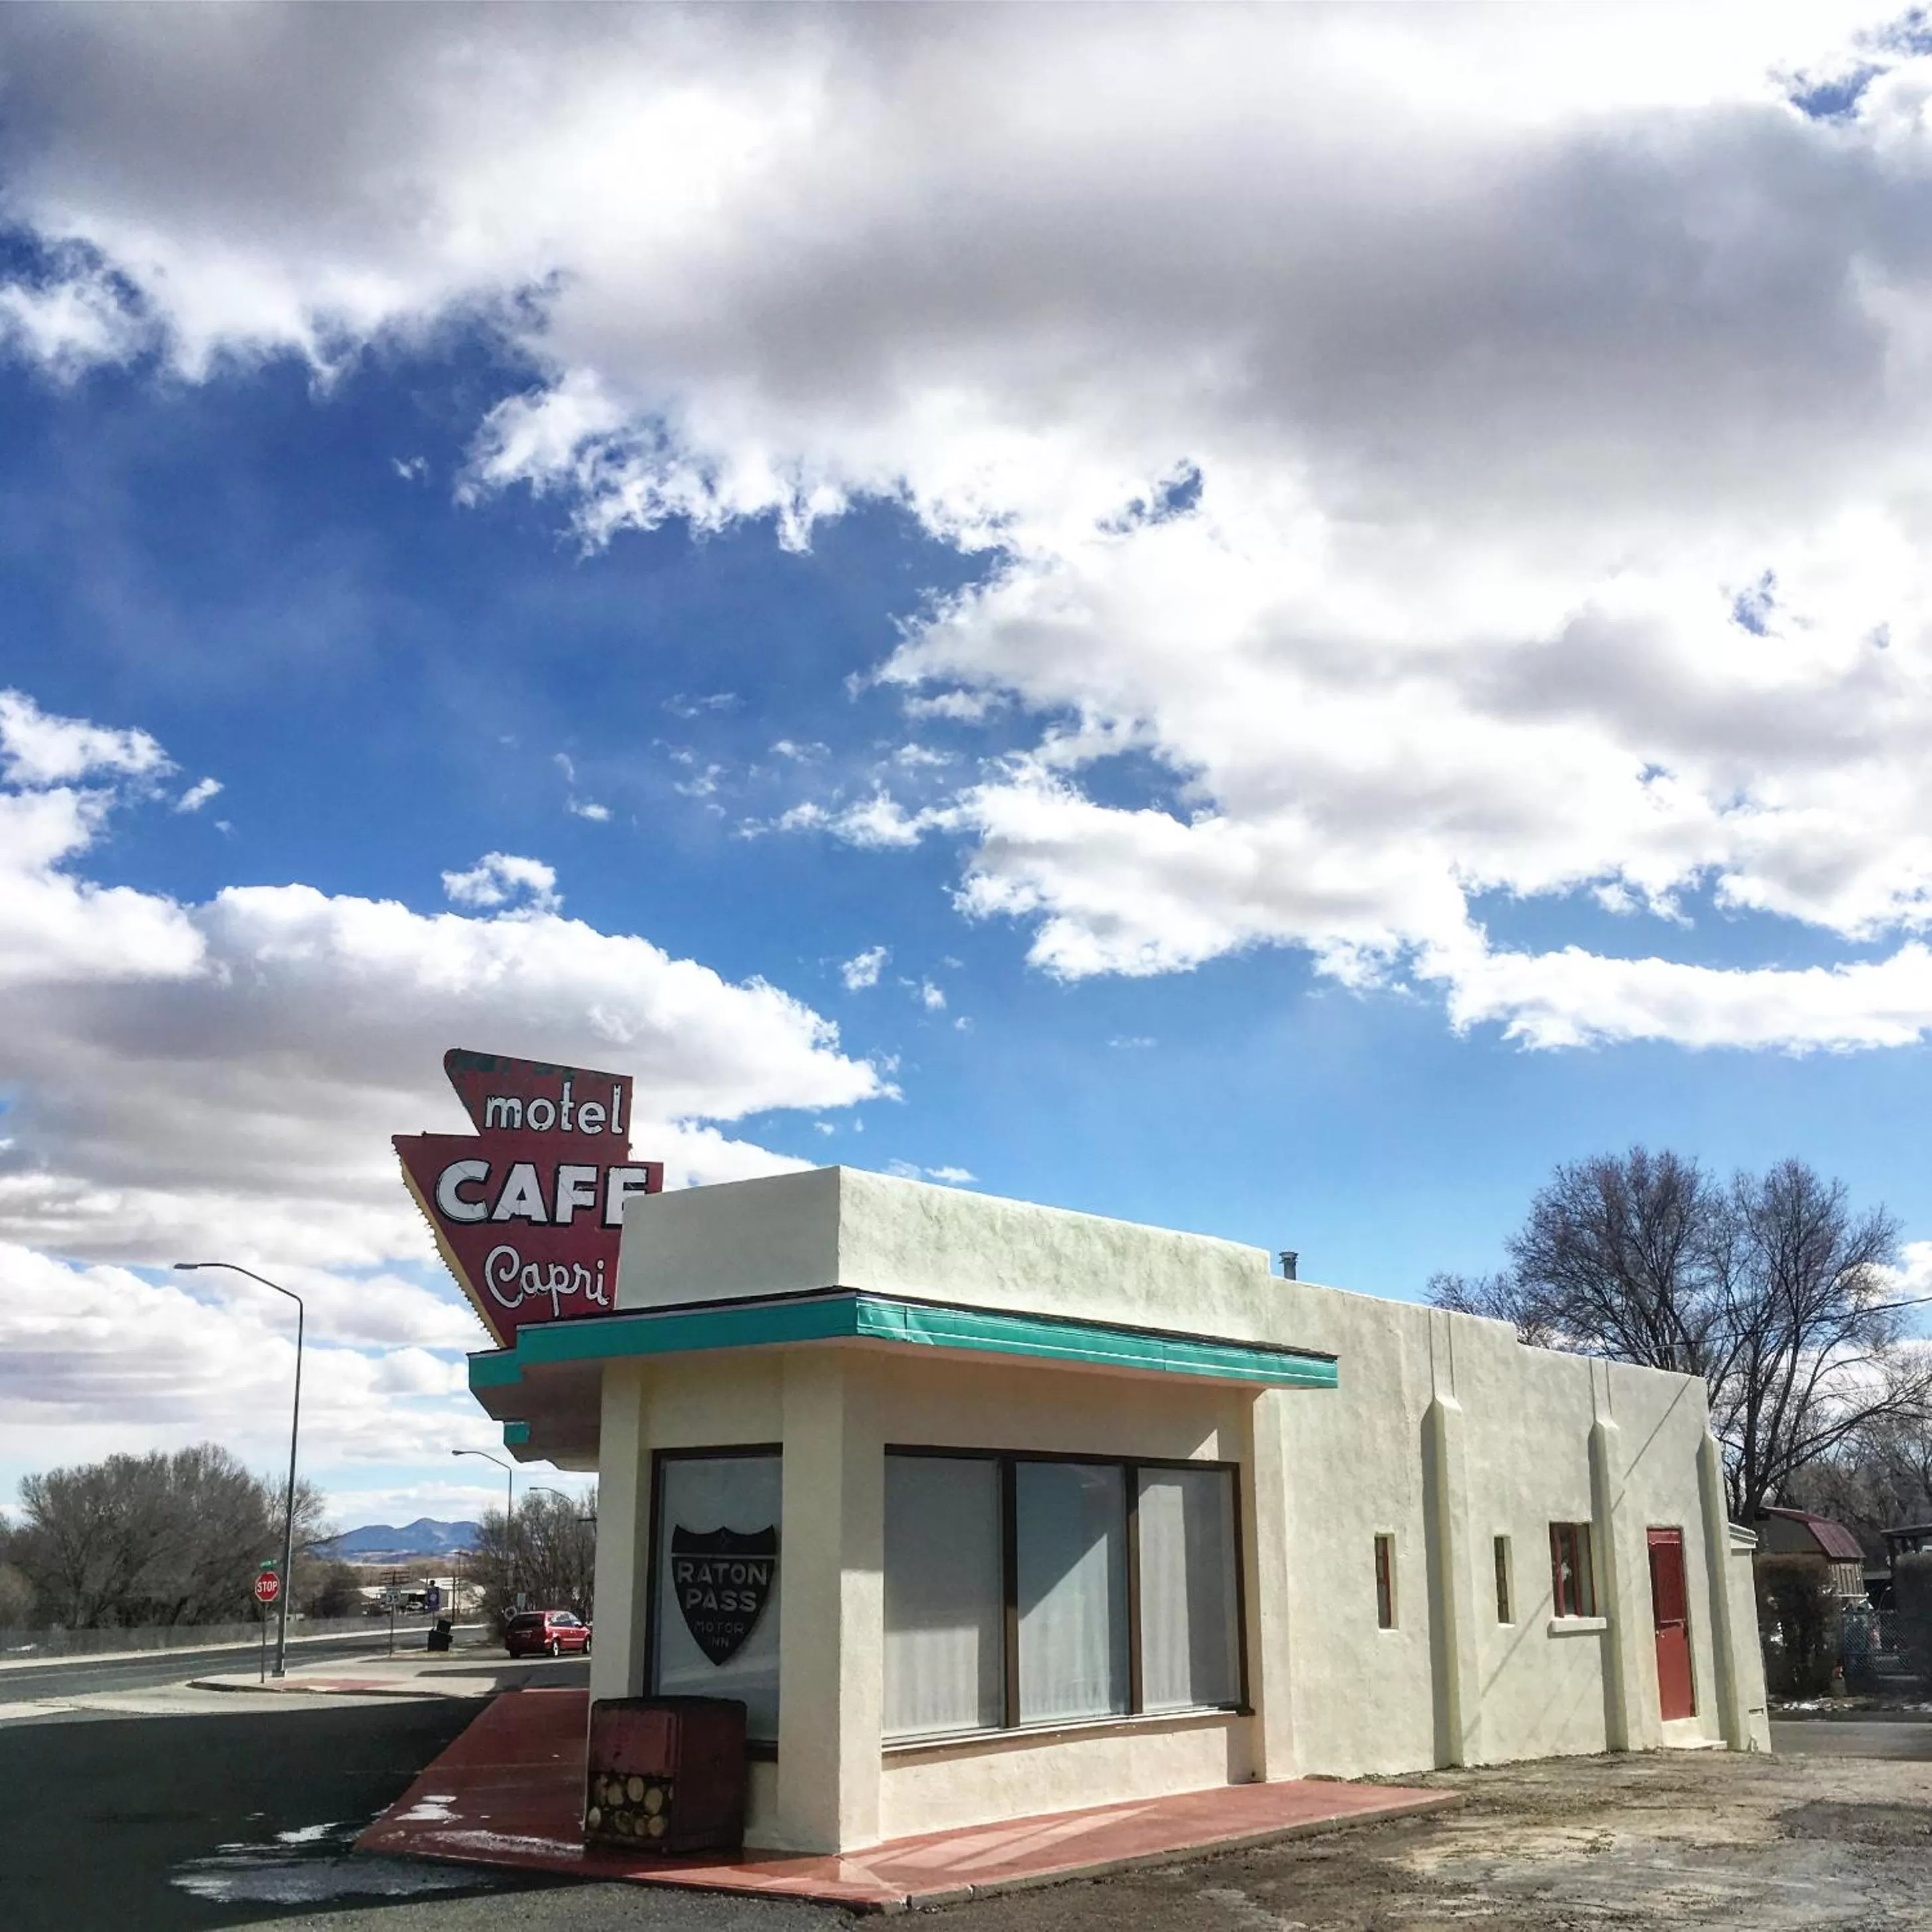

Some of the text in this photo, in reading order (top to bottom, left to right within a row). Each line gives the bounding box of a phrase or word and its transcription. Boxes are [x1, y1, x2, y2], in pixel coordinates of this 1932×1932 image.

[486, 1081, 623, 1135] motel
[485, 1245, 609, 1317] Capri
[677, 1562, 767, 1585] RATON
[257, 1581, 278, 1593] STOP
[686, 1588, 757, 1612] PASS
